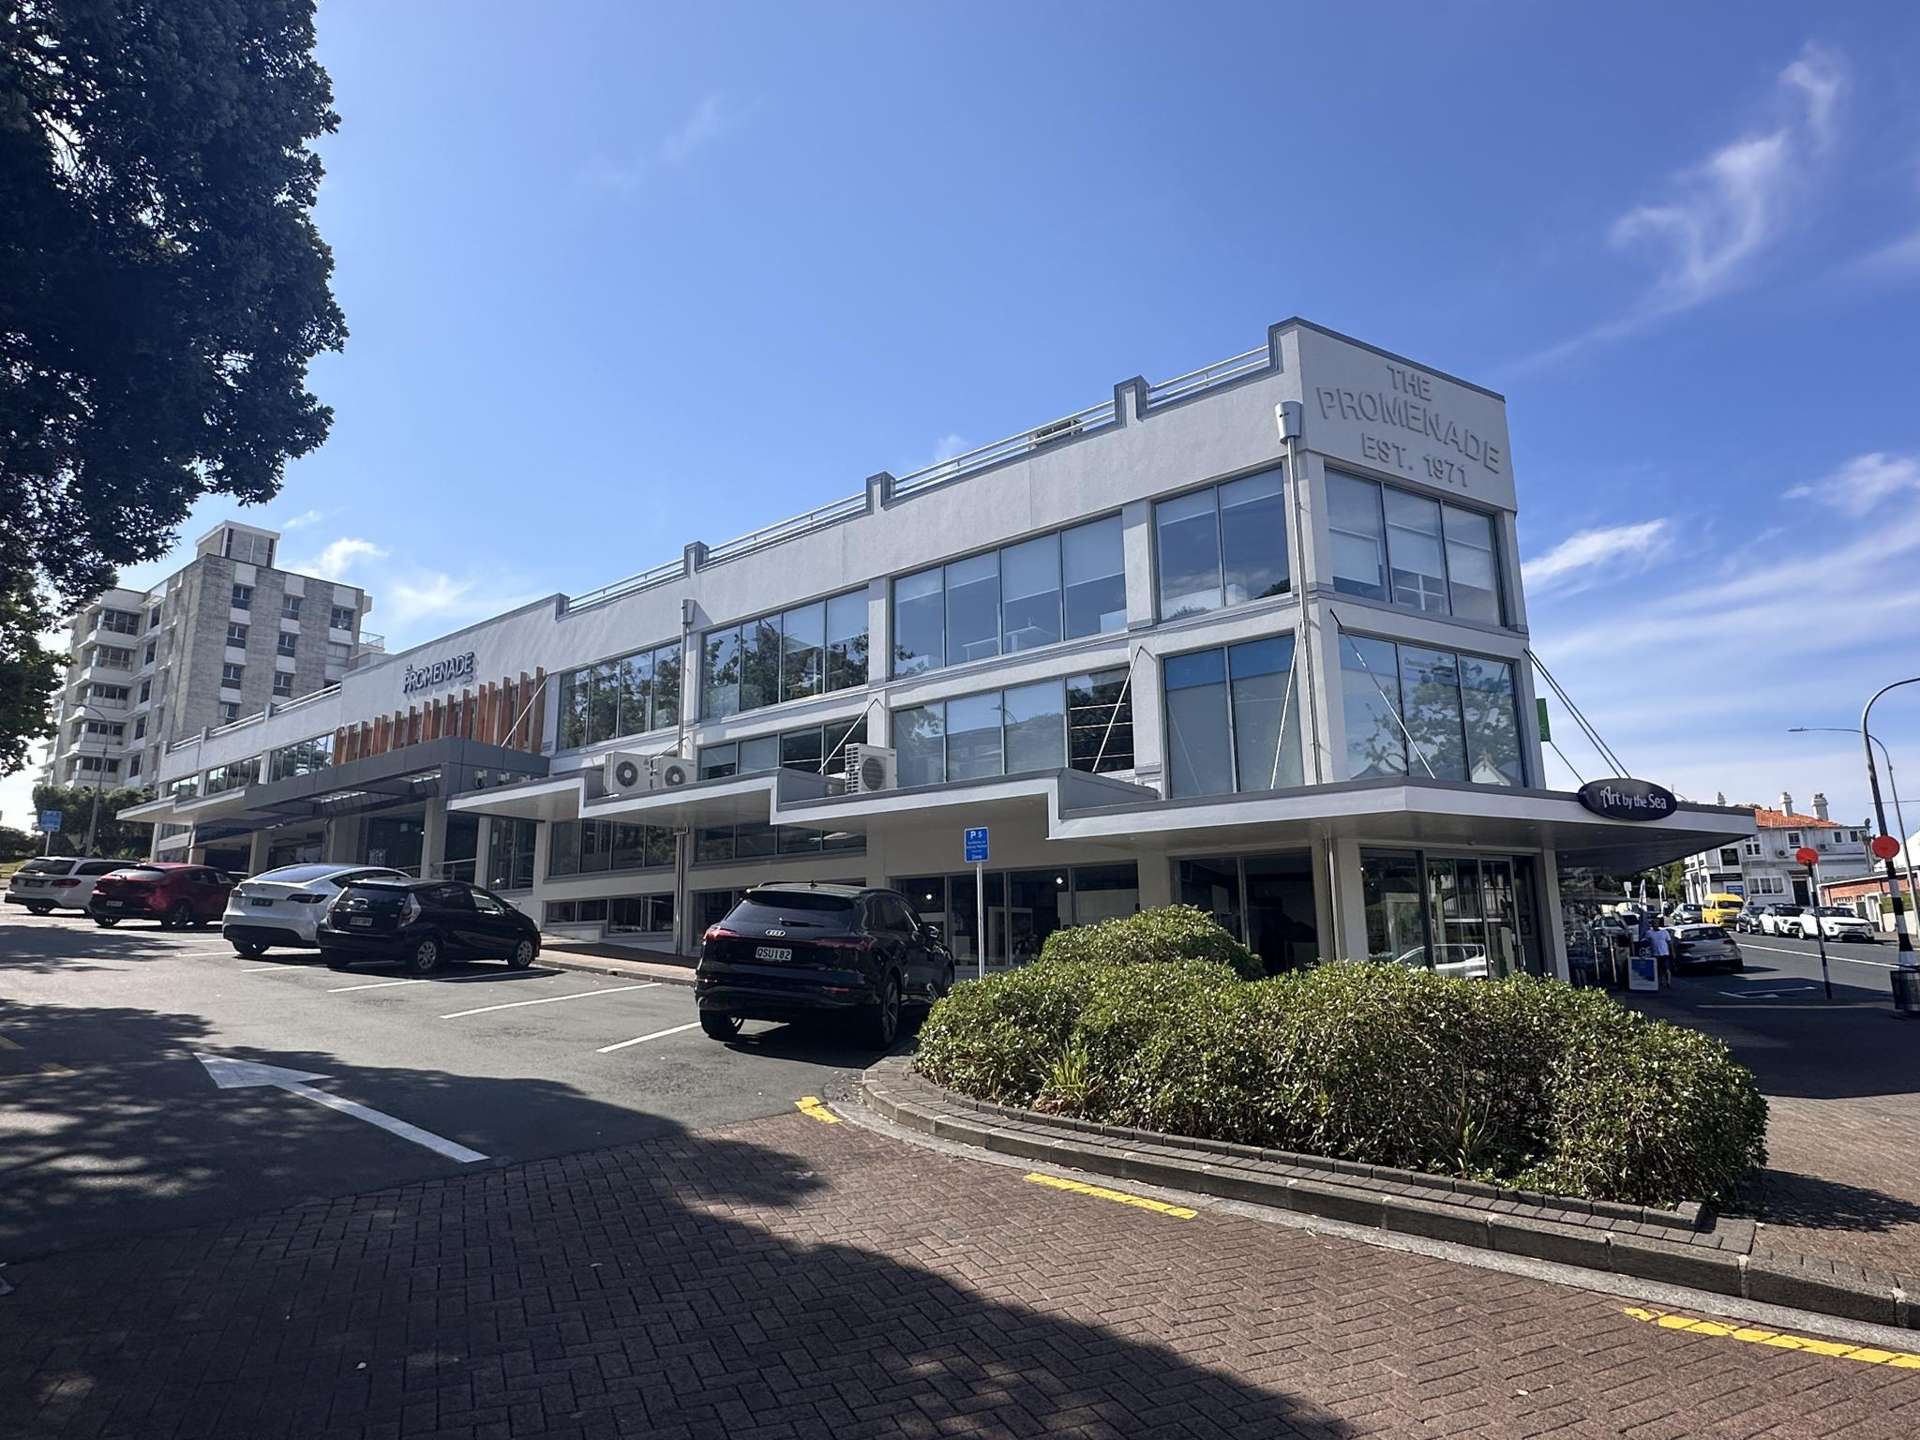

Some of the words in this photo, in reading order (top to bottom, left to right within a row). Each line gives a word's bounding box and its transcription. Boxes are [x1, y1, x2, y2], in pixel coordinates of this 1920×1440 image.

[1386, 364, 1432, 402] THE
[1315, 386, 1501, 475] PROMENADE
[1361, 432, 1414, 471] EST.
[1422, 454, 1468, 488] 1971
[403, 651, 475, 695] PROMENADE
[1600, 786, 1621, 808] Art
[1622, 793, 1633, 810] by
[1633, 794, 1648, 808] the
[1648, 793, 1667, 809] Sea
